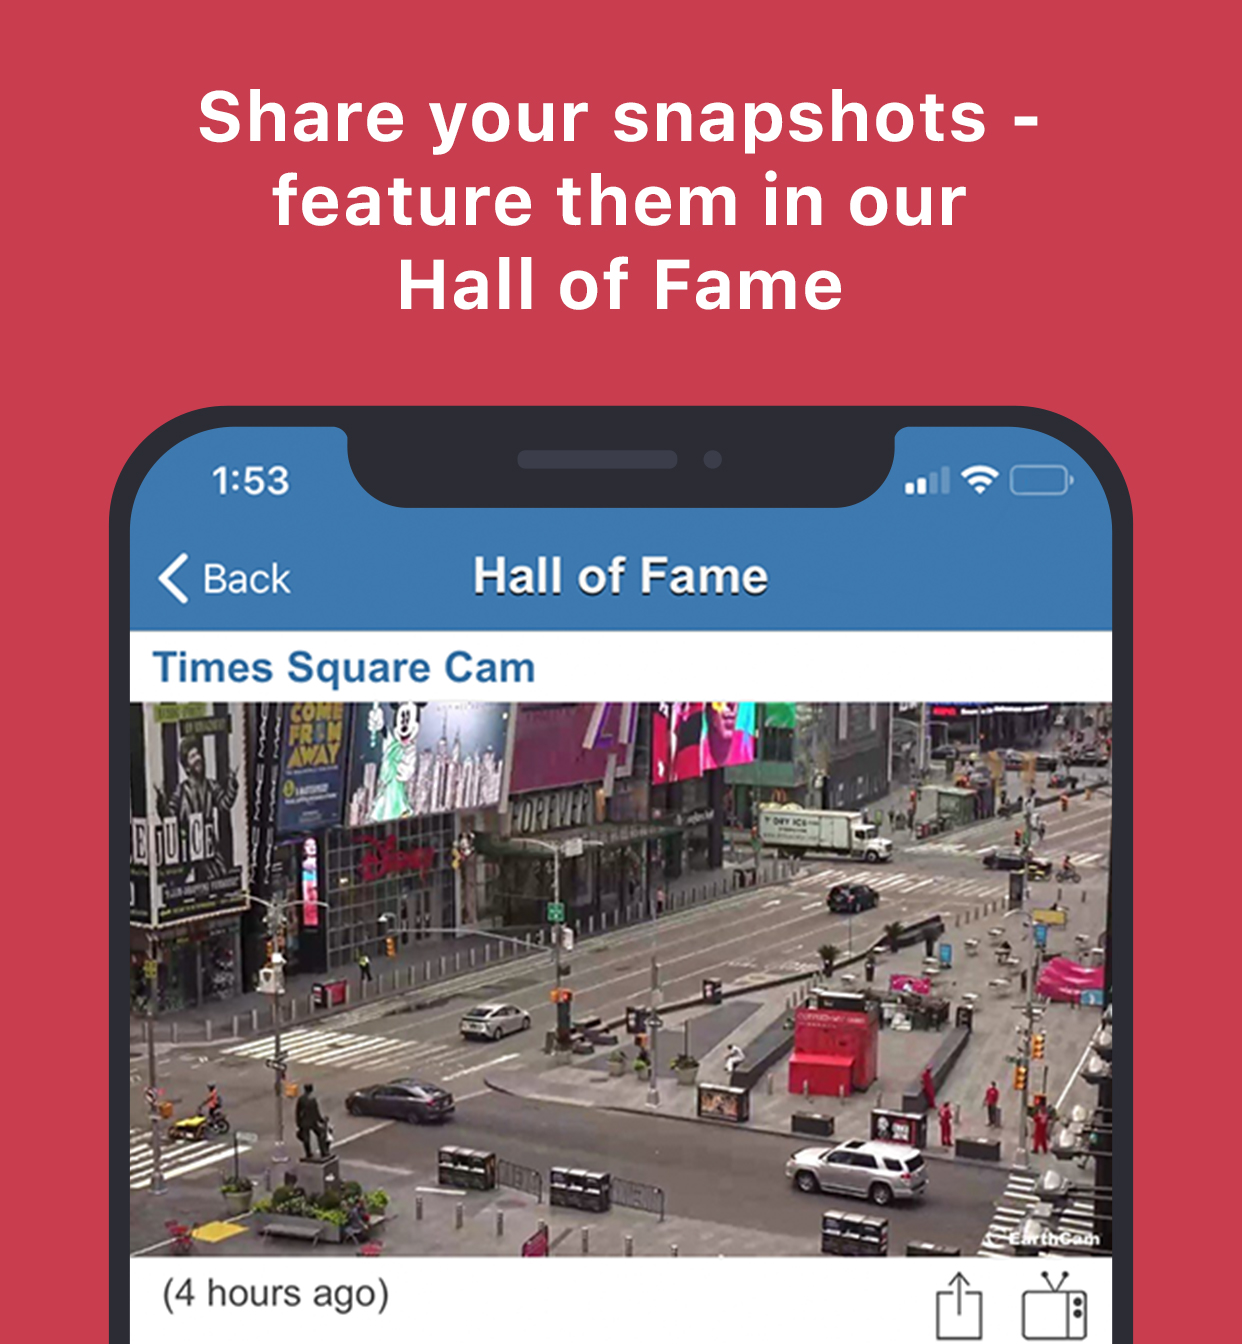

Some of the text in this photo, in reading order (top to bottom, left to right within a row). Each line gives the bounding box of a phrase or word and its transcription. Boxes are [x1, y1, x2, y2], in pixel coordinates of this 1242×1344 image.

[212, 465, 289, 496] 1:53
[204, 562, 291, 595] Back
[474, 556, 768, 596] Hall of Fame
[152, 650, 534, 691] Times Square Cam
[287, 742, 341, 769] AWAY
[163, 1277, 388, 1315] (4 hours ago)
